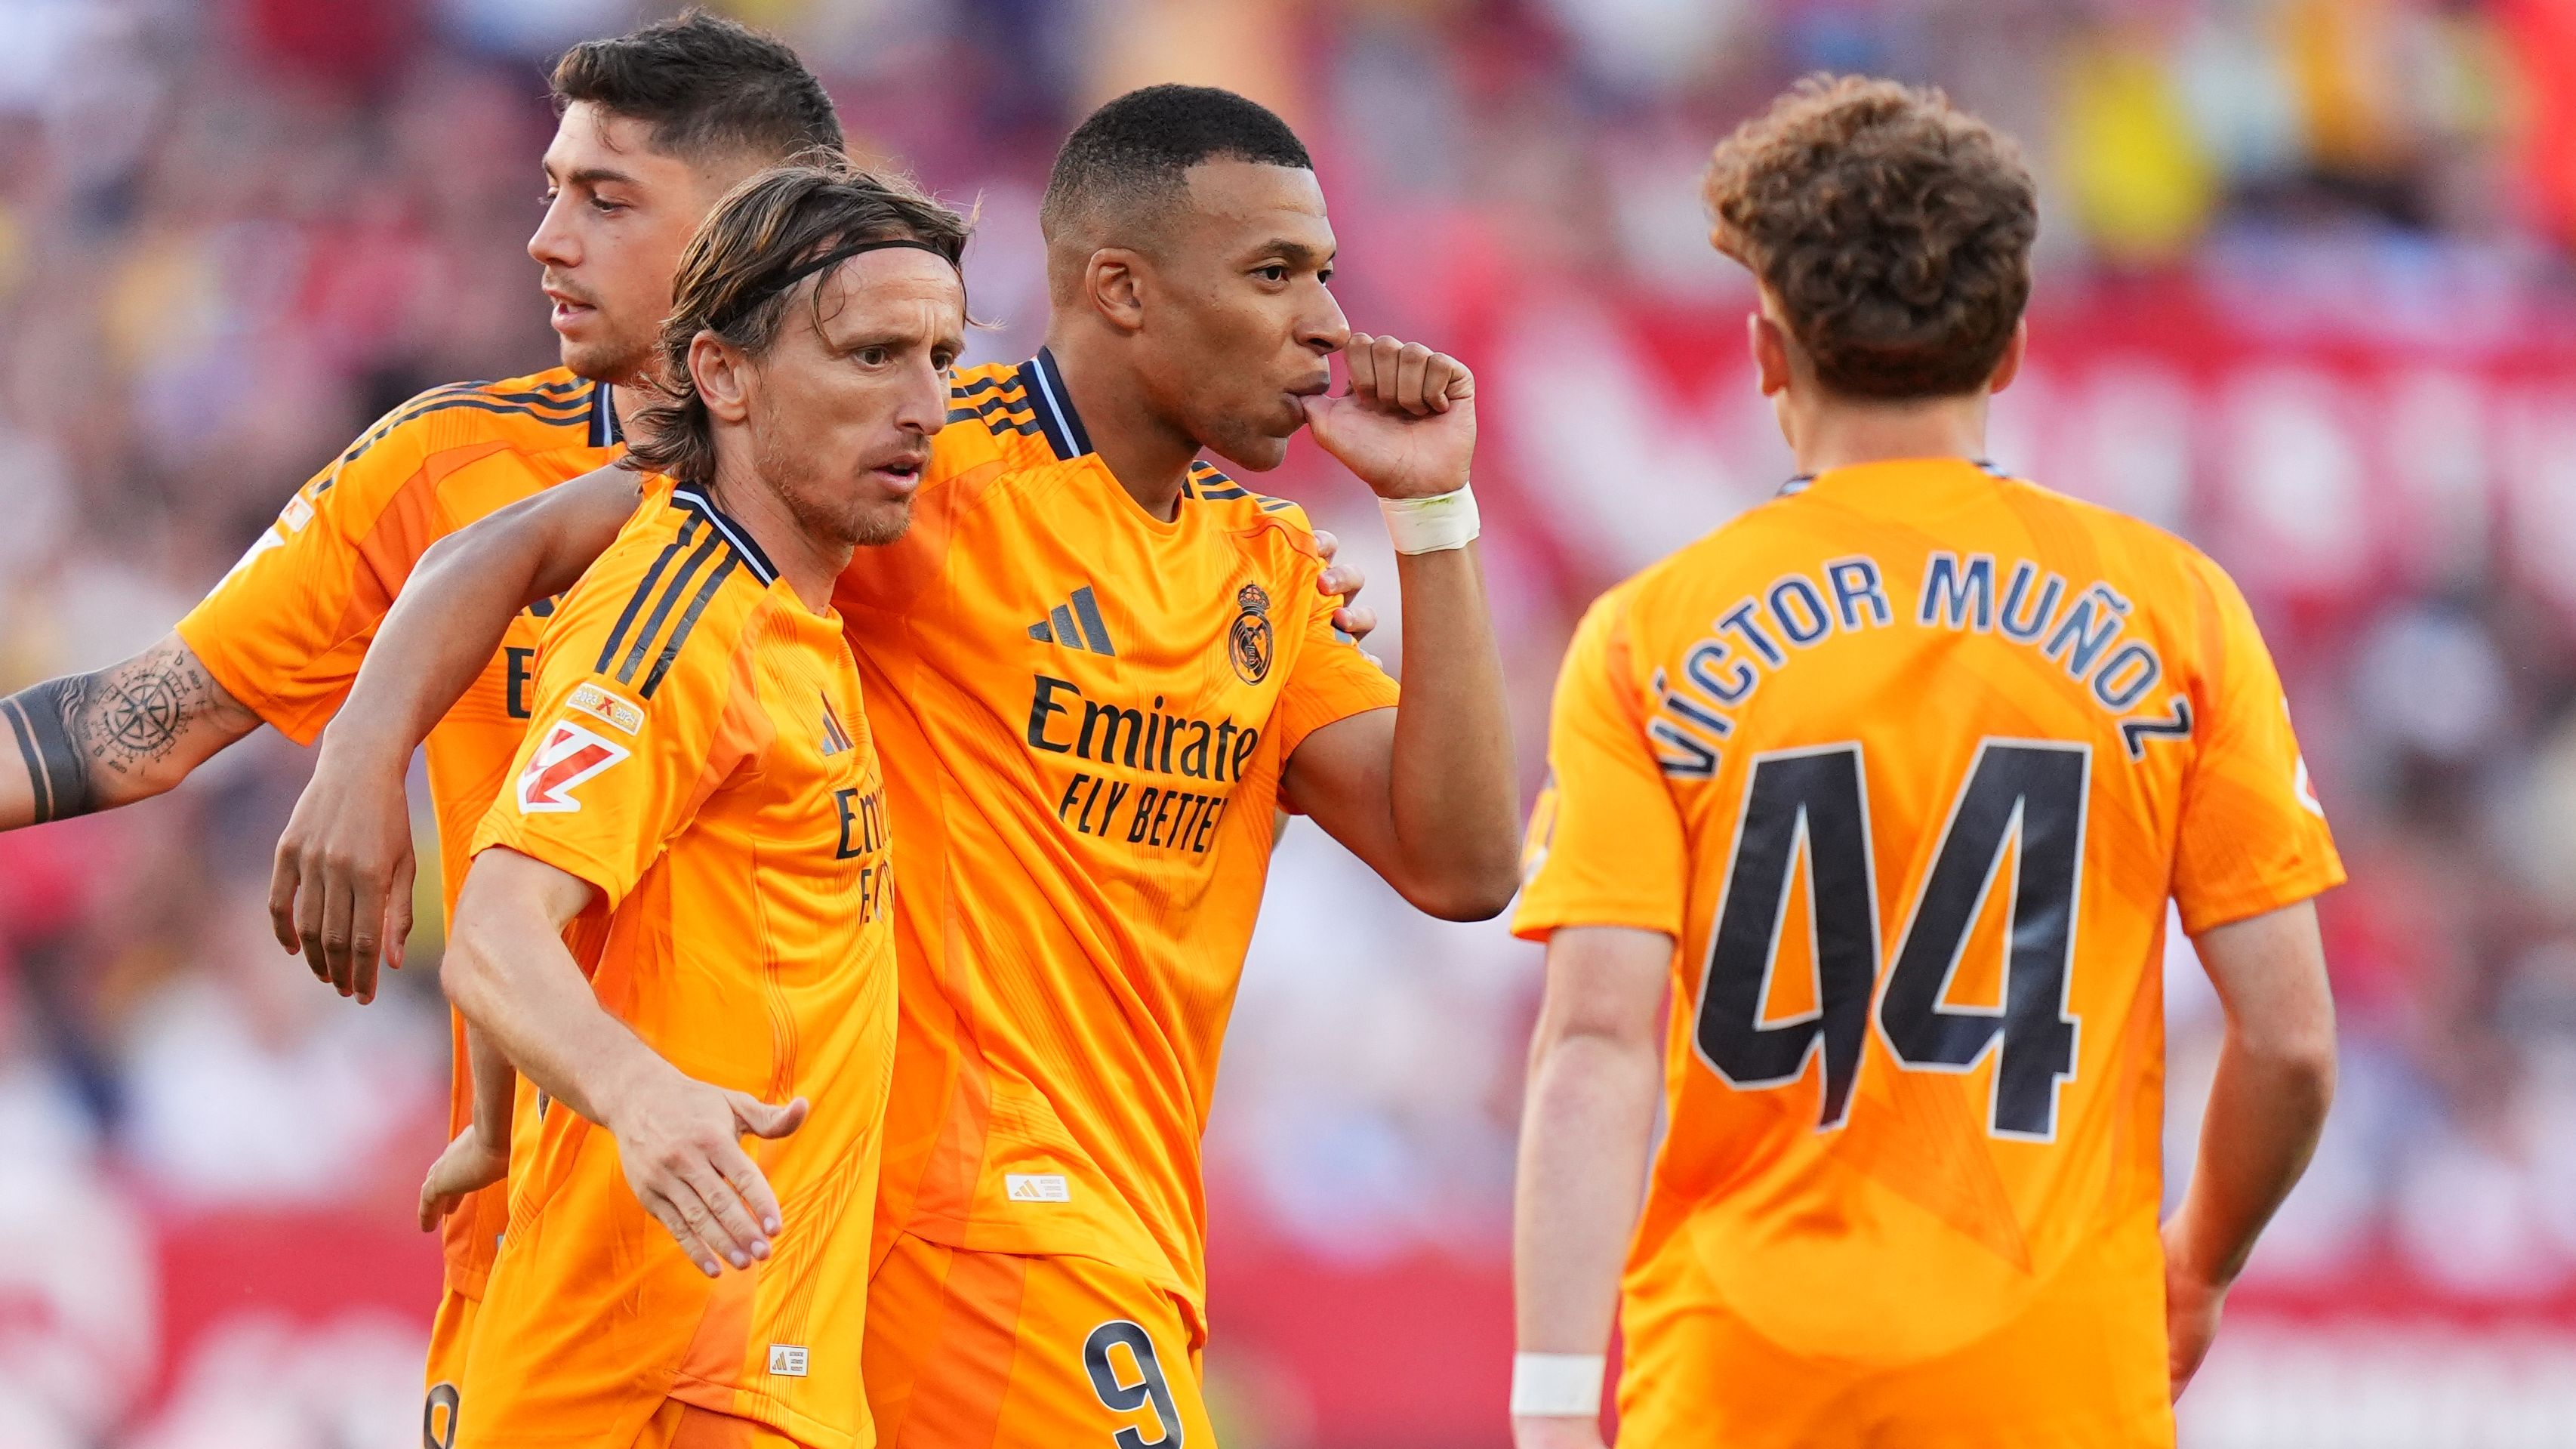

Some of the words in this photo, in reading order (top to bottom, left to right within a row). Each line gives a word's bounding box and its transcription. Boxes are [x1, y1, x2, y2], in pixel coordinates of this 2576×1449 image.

[1647, 555, 1892, 777] VÍCTOR
[1918, 553, 2192, 761] MUÑOZ
[1058, 772, 1129, 837] FLY
[1694, 738, 2091, 1142] 44
[1083, 1319, 1184, 1449] 9
